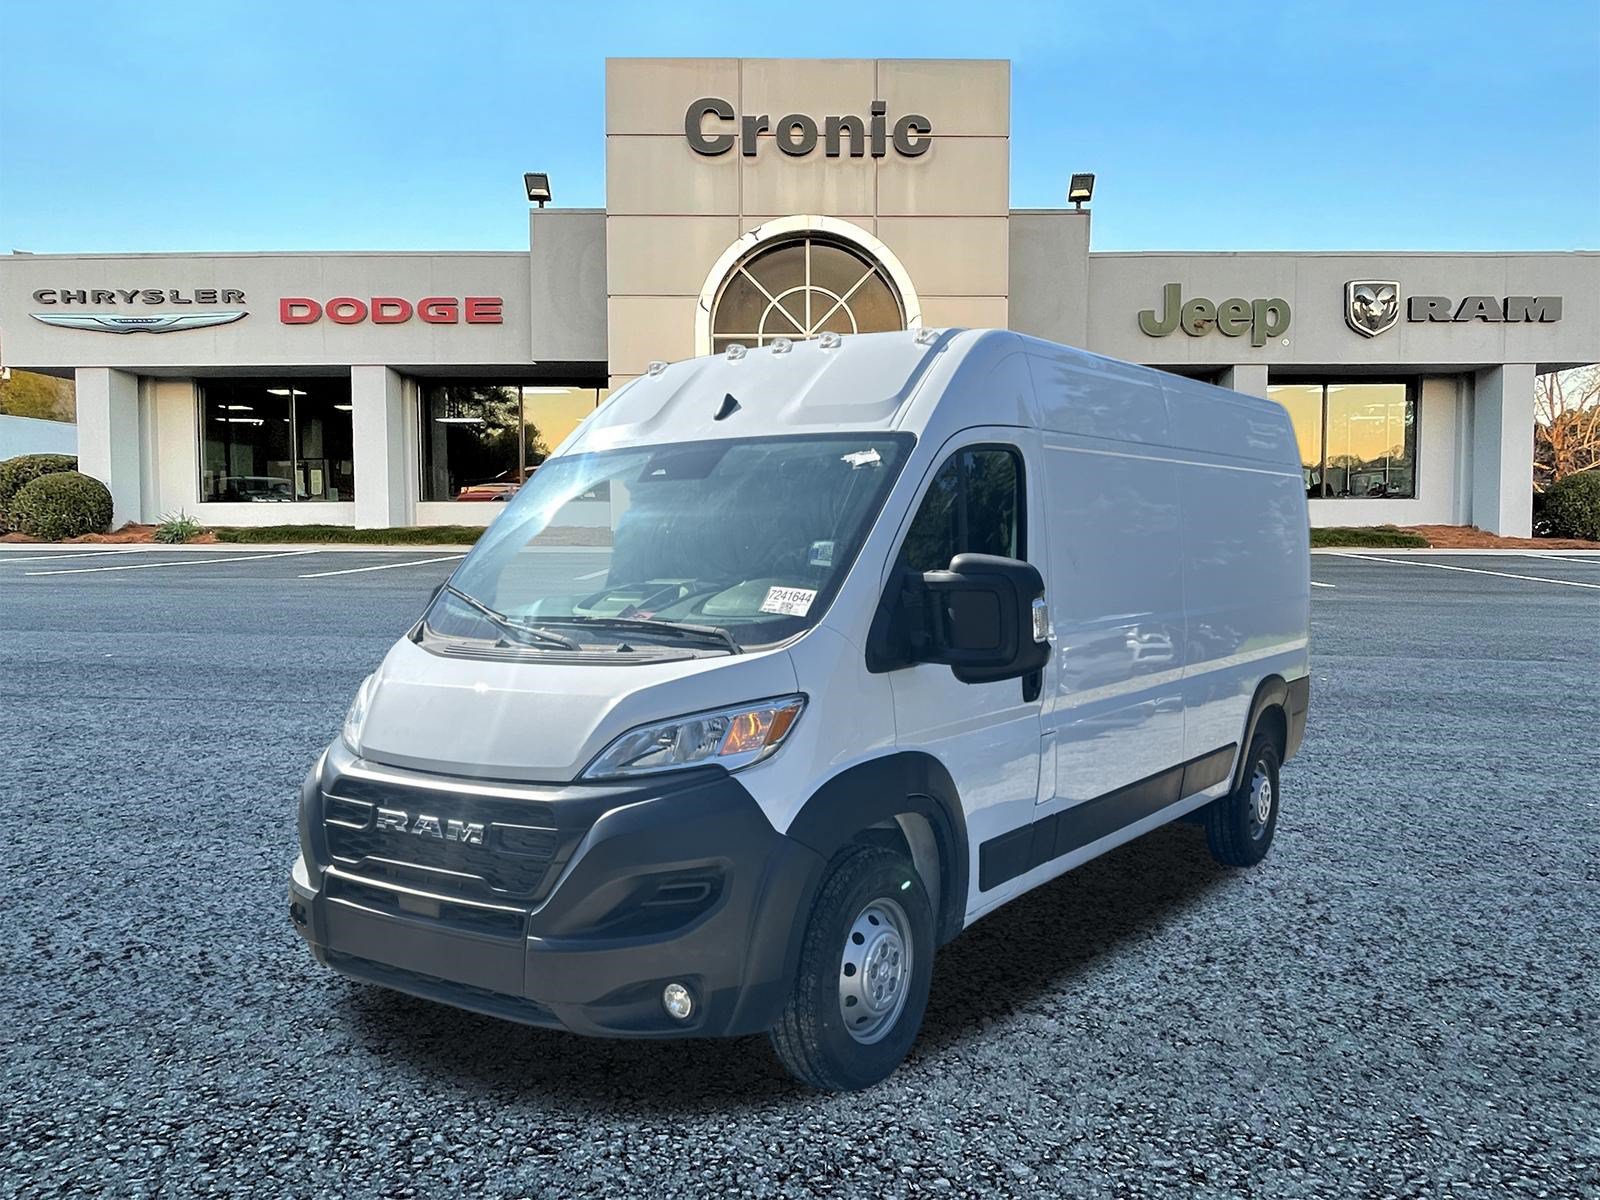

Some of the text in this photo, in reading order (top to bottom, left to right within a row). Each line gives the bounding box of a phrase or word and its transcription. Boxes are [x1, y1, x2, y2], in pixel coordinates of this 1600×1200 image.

[684, 97, 932, 157] Cronic
[32, 288, 247, 305] CHRYSLER
[279, 296, 504, 325] DODGE
[1408, 296, 1563, 323] RAM
[1138, 283, 1292, 347] Jeep
[768, 589, 813, 603] 7241644
[376, 807, 485, 845] RAM
